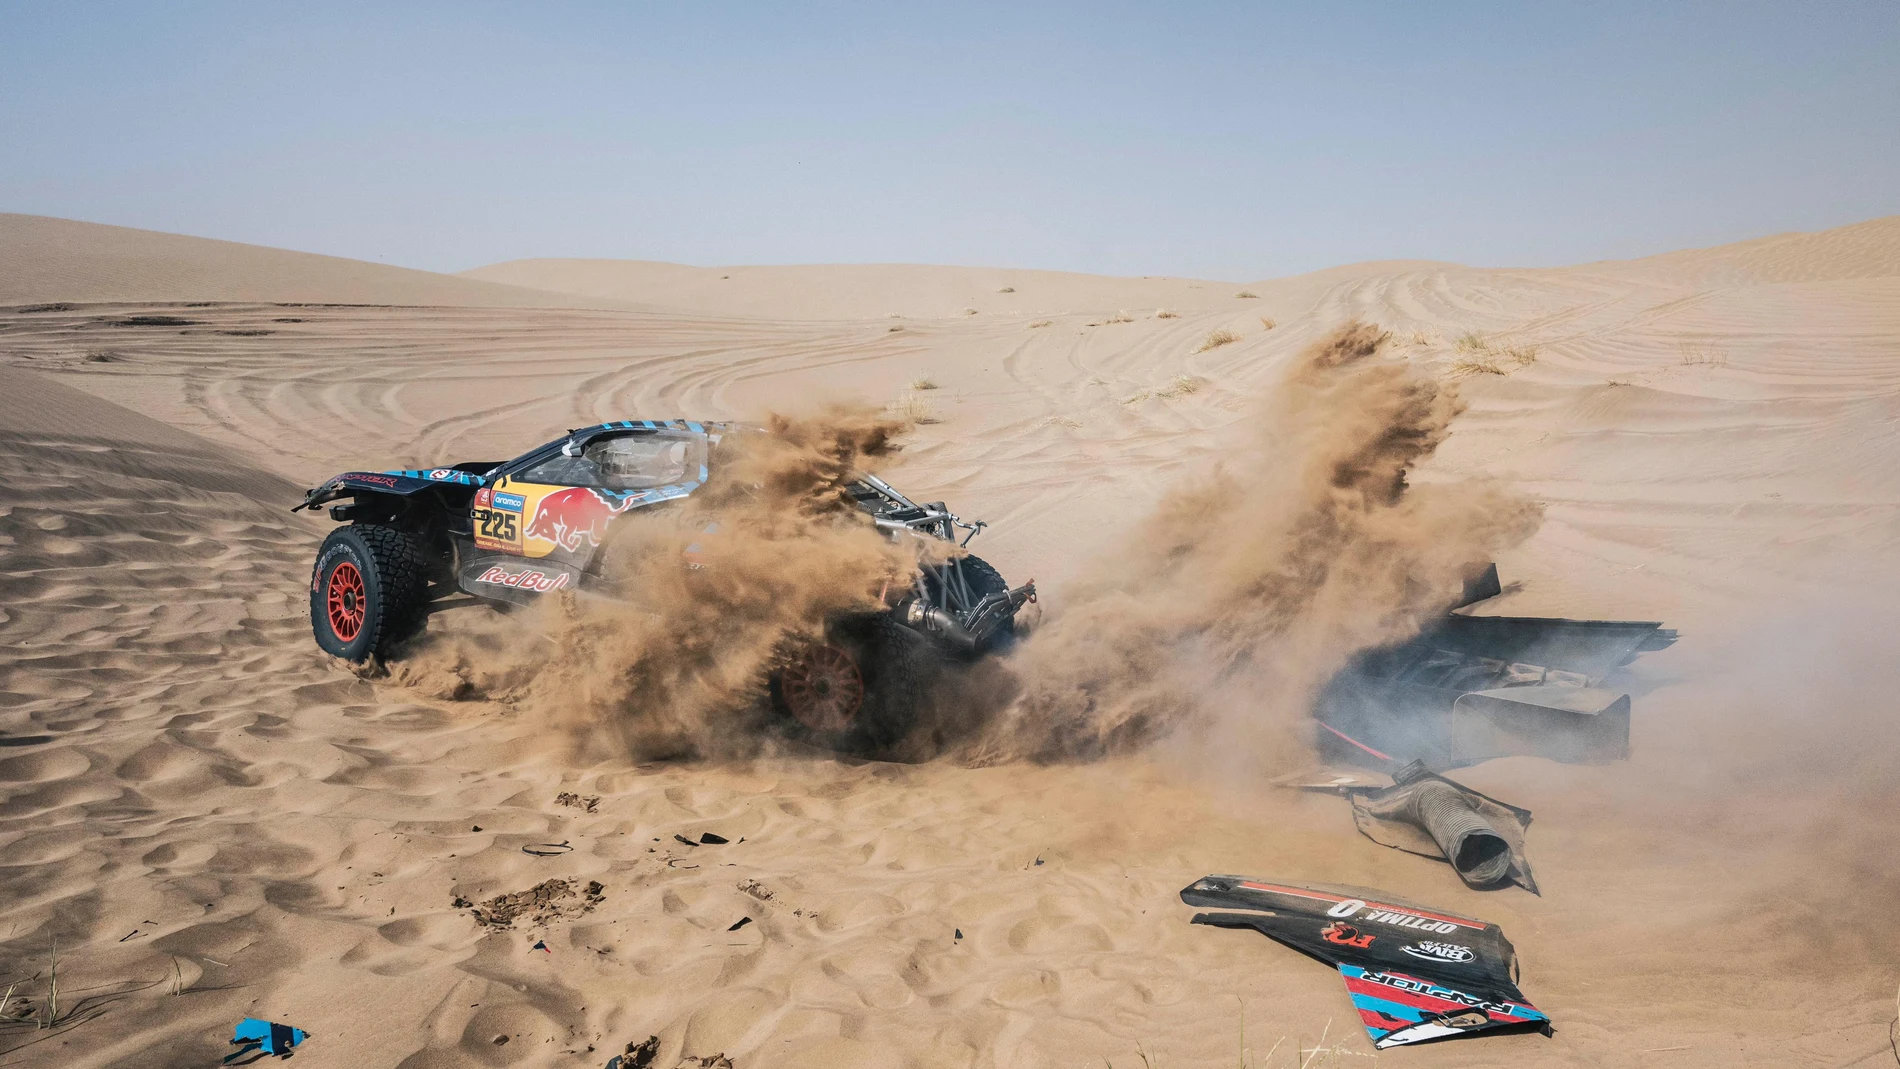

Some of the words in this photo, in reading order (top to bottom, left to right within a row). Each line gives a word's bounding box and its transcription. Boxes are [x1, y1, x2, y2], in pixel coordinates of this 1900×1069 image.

[495, 496, 522, 507] aramco
[481, 510, 516, 542] 225
[1365, 909, 1458, 934] OPTIMA
[1359, 968, 1516, 1015] RAPTOR
